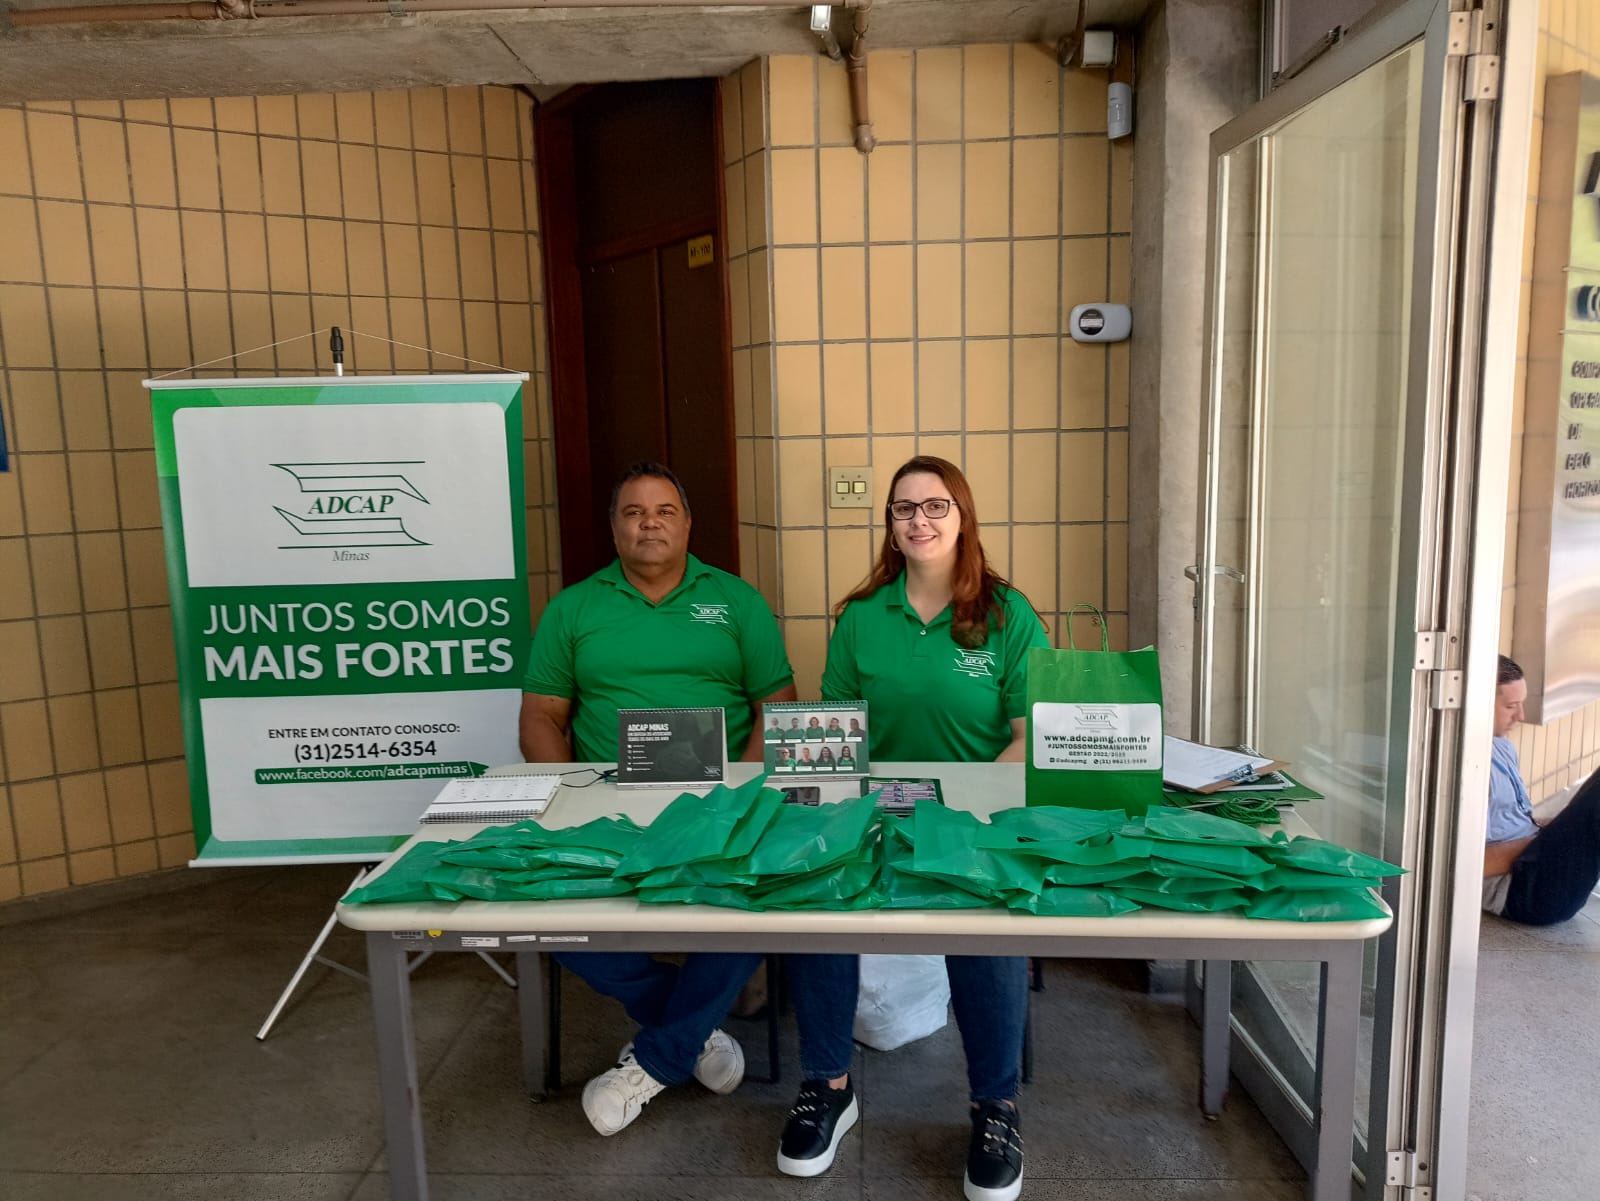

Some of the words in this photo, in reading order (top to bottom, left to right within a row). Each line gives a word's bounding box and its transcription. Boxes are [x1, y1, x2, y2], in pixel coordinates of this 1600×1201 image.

[307, 495, 394, 516] ADCAP
[332, 550, 370, 563] Minas
[203, 602, 354, 635] JUNTOS
[366, 597, 511, 631] SOMOS
[203, 644, 323, 682] MAIS
[335, 638, 514, 679] FORTES
[268, 728, 307, 739] ENTRE
[311, 727, 329, 738] EM
[332, 725, 392, 737] CONTATO
[394, 723, 461, 735] CONOSCO:
[1044, 734, 1151, 744] www.adcapmg.com.br
[294, 740, 437, 763] (31)2514-6354
[258, 763, 468, 782] www.facebook.com/adcapminas
